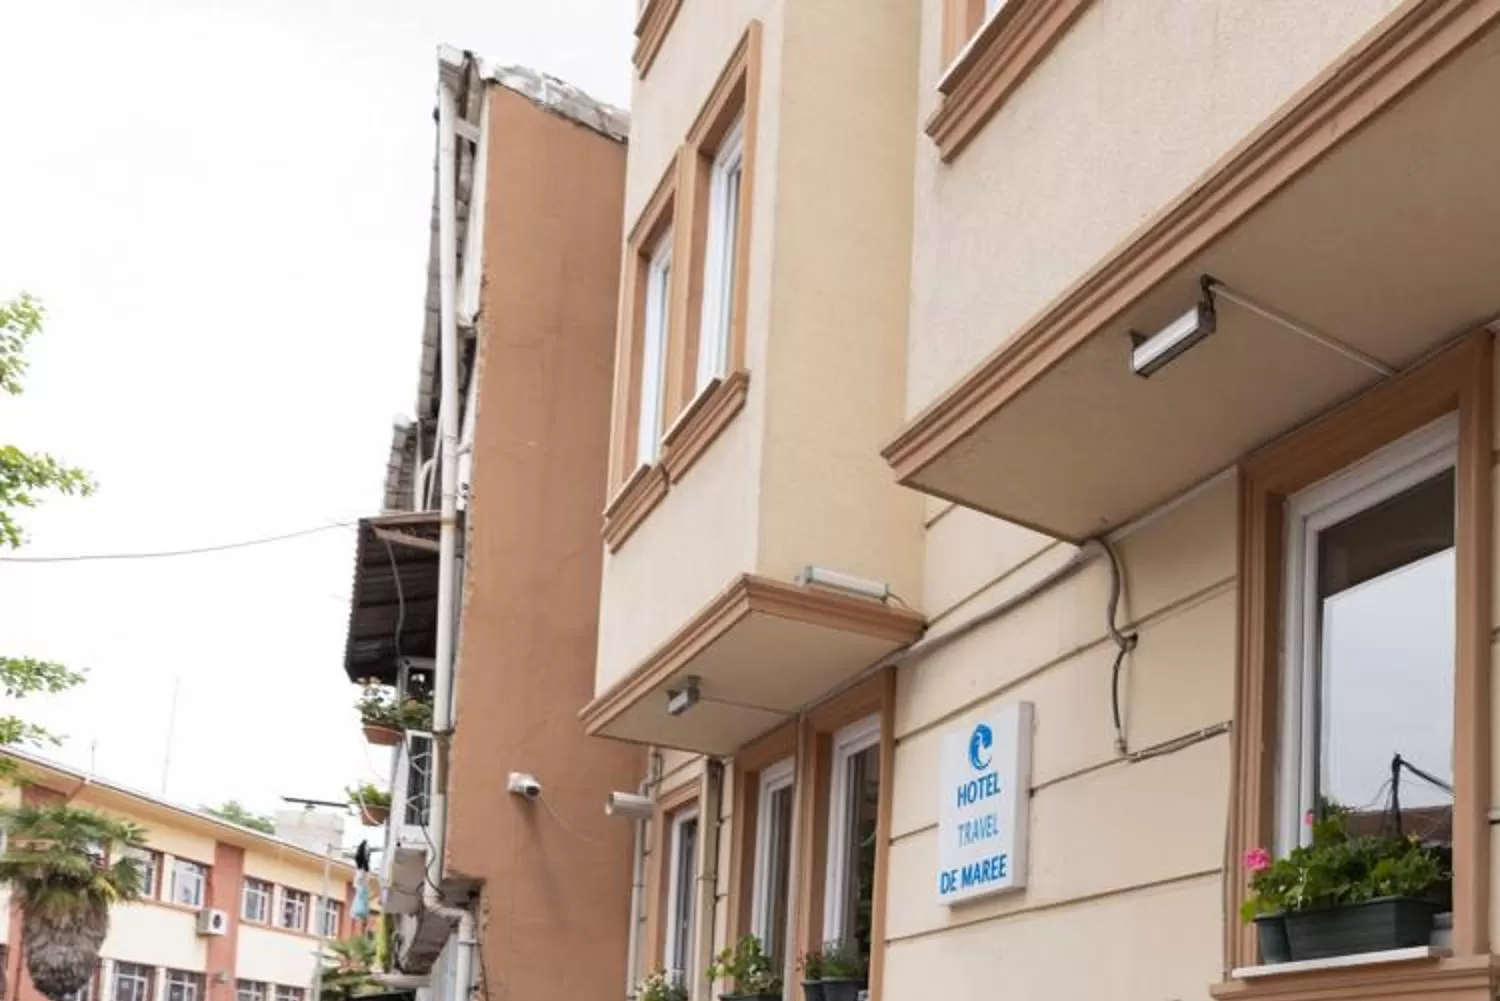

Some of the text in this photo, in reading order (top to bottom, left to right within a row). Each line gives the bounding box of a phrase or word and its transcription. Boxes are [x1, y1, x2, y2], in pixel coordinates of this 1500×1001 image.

[956, 772, 1001, 808] HOTEL
[957, 813, 1000, 848] TRAVEL
[940, 854, 1007, 894] DE MAREE
